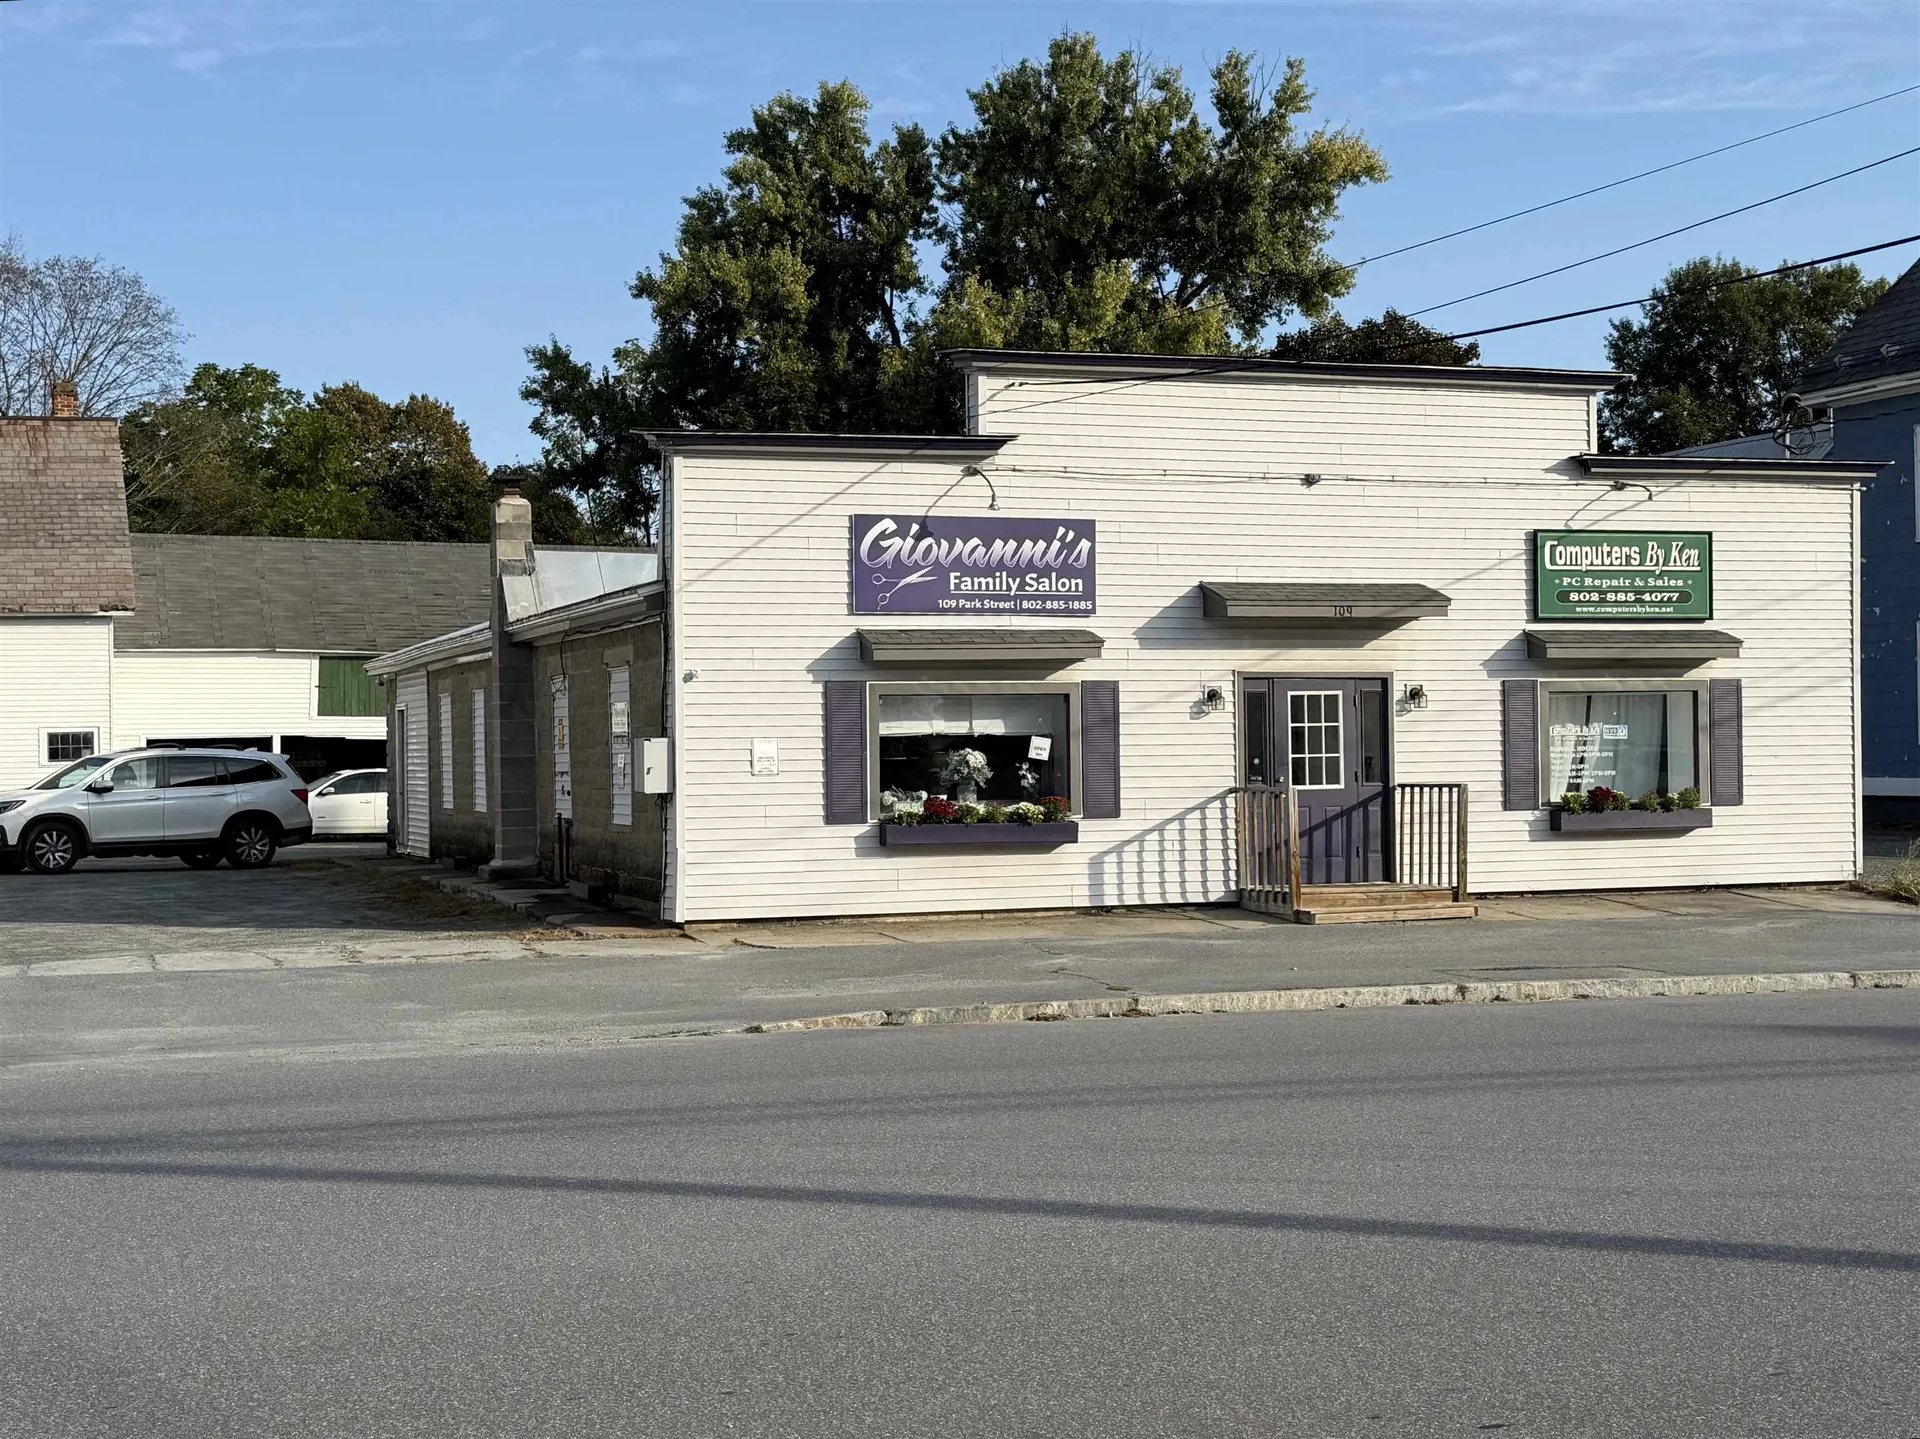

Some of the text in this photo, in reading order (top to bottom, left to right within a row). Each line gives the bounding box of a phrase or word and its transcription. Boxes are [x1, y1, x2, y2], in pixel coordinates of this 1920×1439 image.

[860, 517, 1092, 569] Giovanni's
[1544, 540, 1700, 575] Computers By Ken
[950, 571, 1083, 596] Family Salon
[1562, 577, 1684, 588] PC Repair & Sales
[1569, 592, 1680, 602] 802-885-4077
[938, 599, 1093, 610] 109 Park Street 802-885-1885
[1334, 605, 1353, 619] 109
